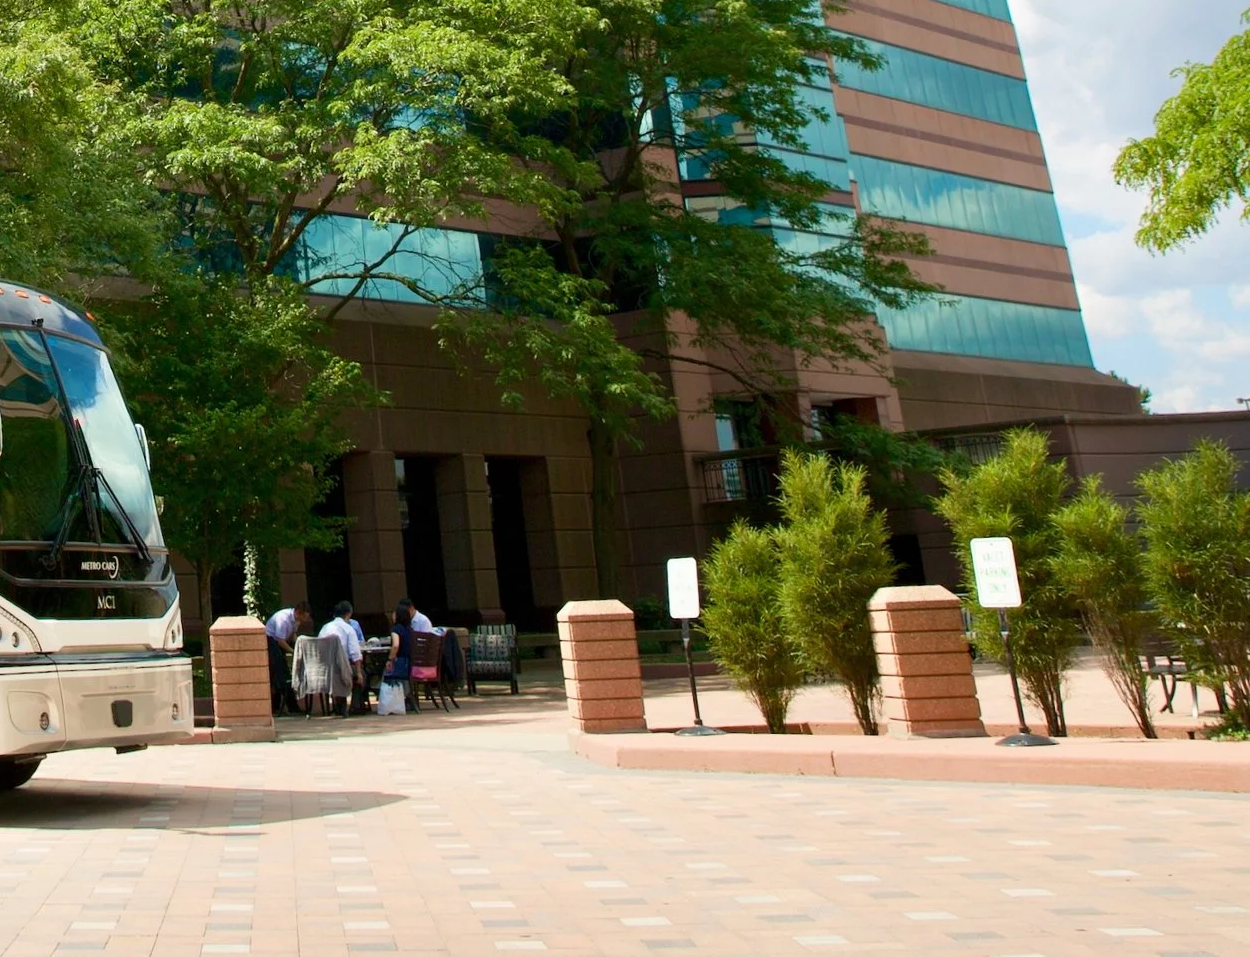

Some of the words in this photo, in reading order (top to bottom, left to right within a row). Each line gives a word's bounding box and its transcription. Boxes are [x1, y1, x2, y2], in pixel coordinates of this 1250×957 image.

[81, 561, 101, 571] METRO
[101, 561, 116, 571] CARS
[97, 595, 116, 609] MCI
